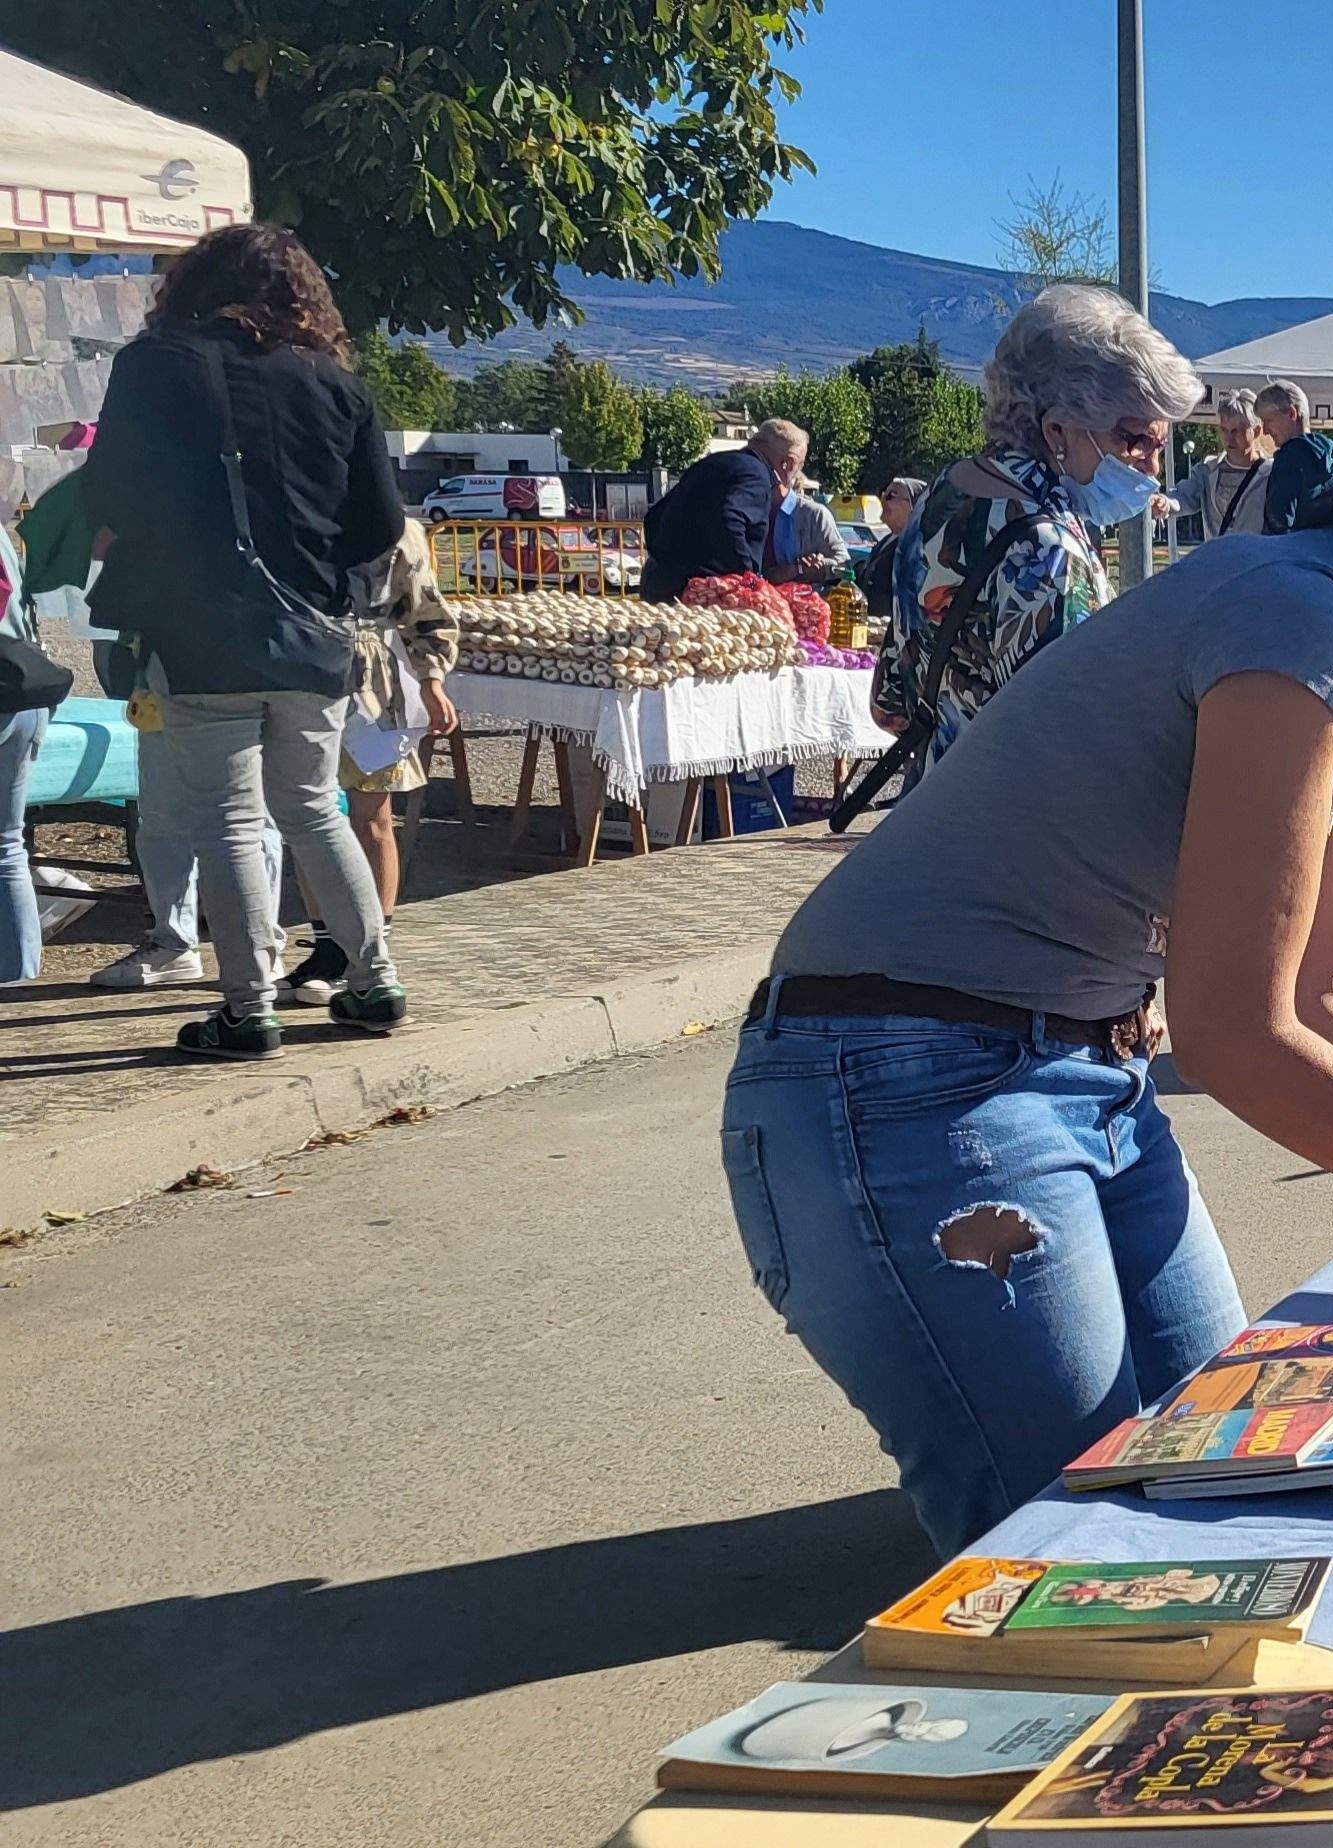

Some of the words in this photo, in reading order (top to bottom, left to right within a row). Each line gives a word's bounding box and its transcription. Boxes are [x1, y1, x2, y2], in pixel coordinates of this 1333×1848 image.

[1246, 1409, 1296, 1455] MADRID
[1202, 1712, 1253, 1732] de
[1183, 1734, 1238, 1750] la
[1196, 1723, 1287, 1788] Morena
[1252, 1741, 1305, 1765] La
[1134, 1752, 1211, 1801] Copla
